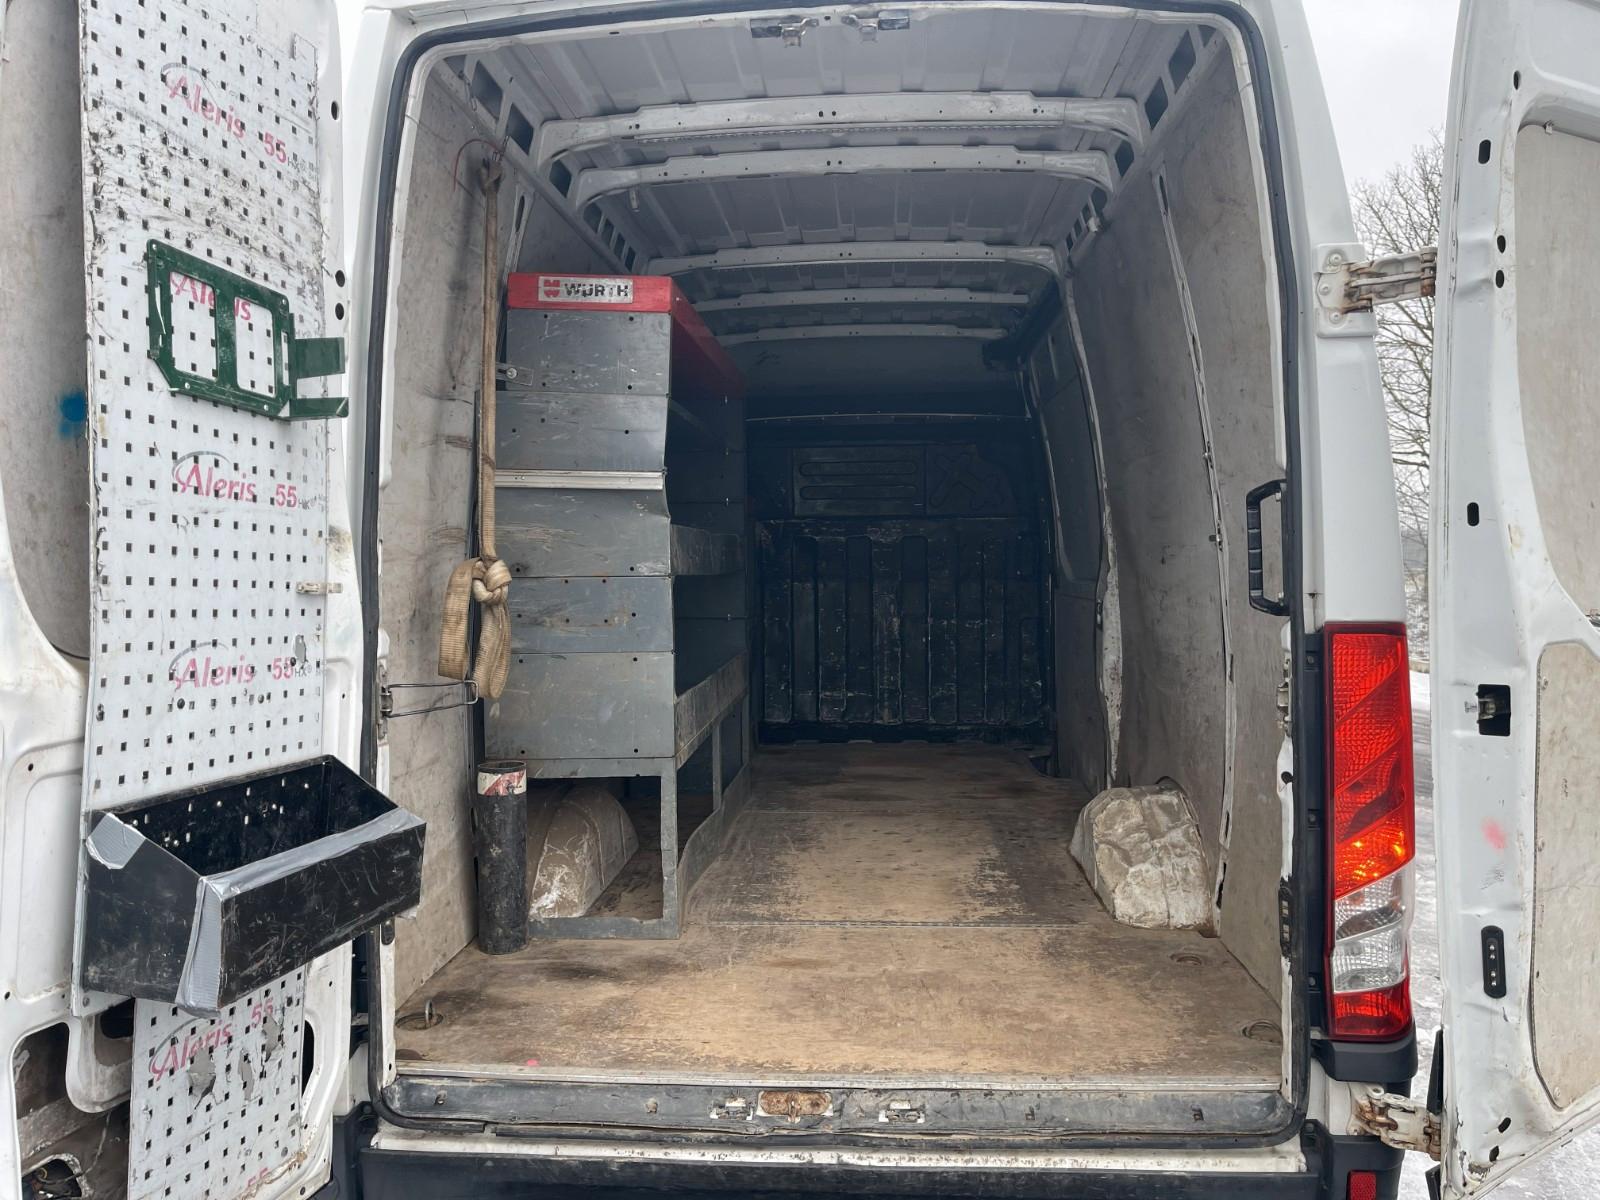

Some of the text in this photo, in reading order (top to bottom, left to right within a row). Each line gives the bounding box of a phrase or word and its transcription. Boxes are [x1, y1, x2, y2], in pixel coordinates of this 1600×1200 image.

[162, 73, 245, 139] Aleris
[564, 282, 629, 298] WÜRTH
[174, 463, 258, 503] Aleris
[171, 654, 257, 690] Aleris
